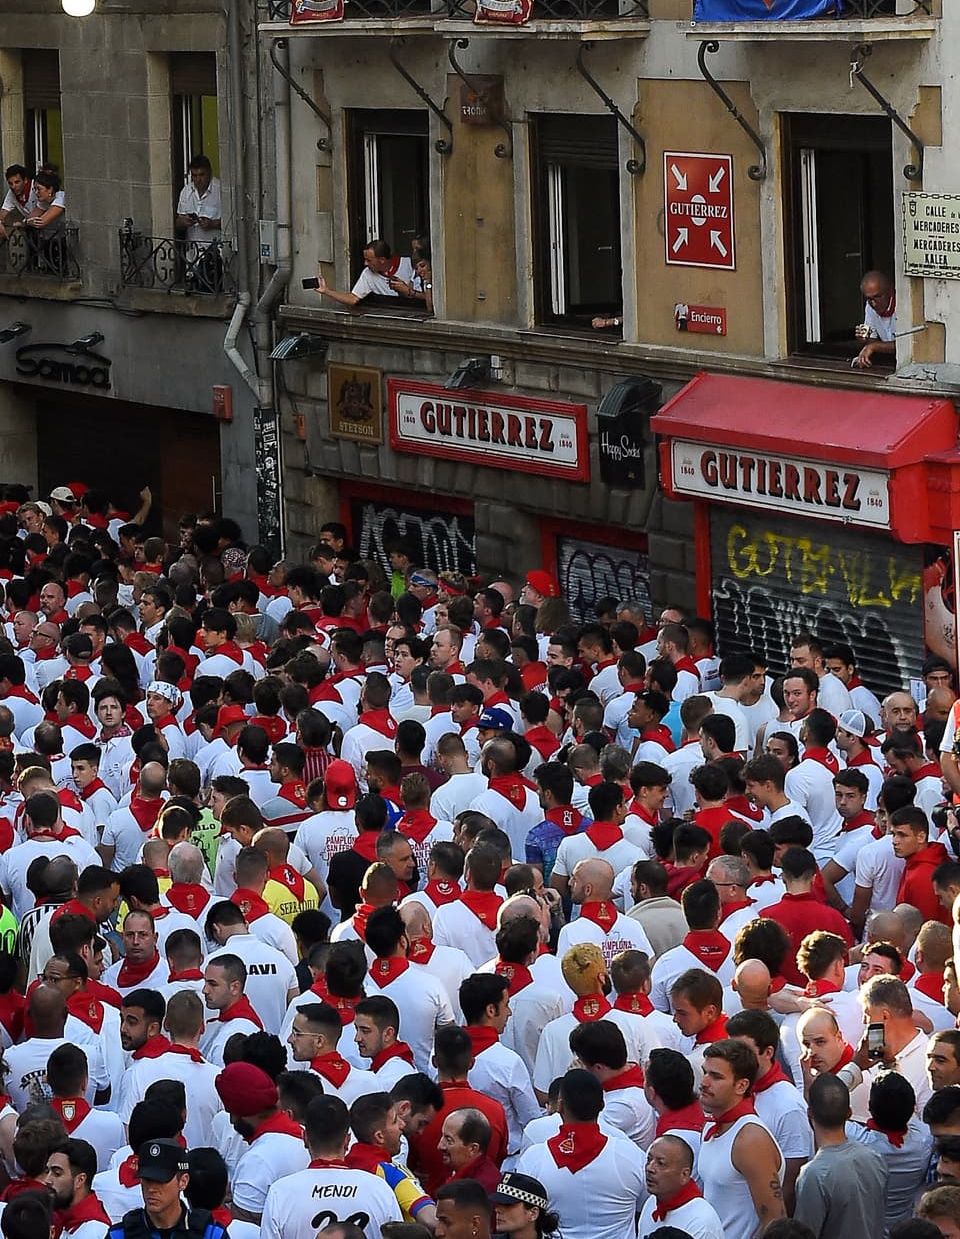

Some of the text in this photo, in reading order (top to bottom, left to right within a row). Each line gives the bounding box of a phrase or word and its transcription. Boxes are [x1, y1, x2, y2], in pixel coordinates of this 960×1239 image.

[670, 202, 727, 218] GUTIERREZ
[926, 206, 946, 217] CALLE
[913, 220, 960, 233] MERCADERES
[925, 254, 948, 265] KALEA
[691, 311, 722, 324] Encierro
[339, 421, 374, 436] STETSON
[420, 401, 554, 453] GUTIERREZ
[601, 431, 621, 461] Happy
[700, 450, 861, 511] GUTIERREZ
[867, 497, 883, 507] 1840
[246, 964, 277, 975] AVI
[312, 1185, 358, 1198] MENDI
